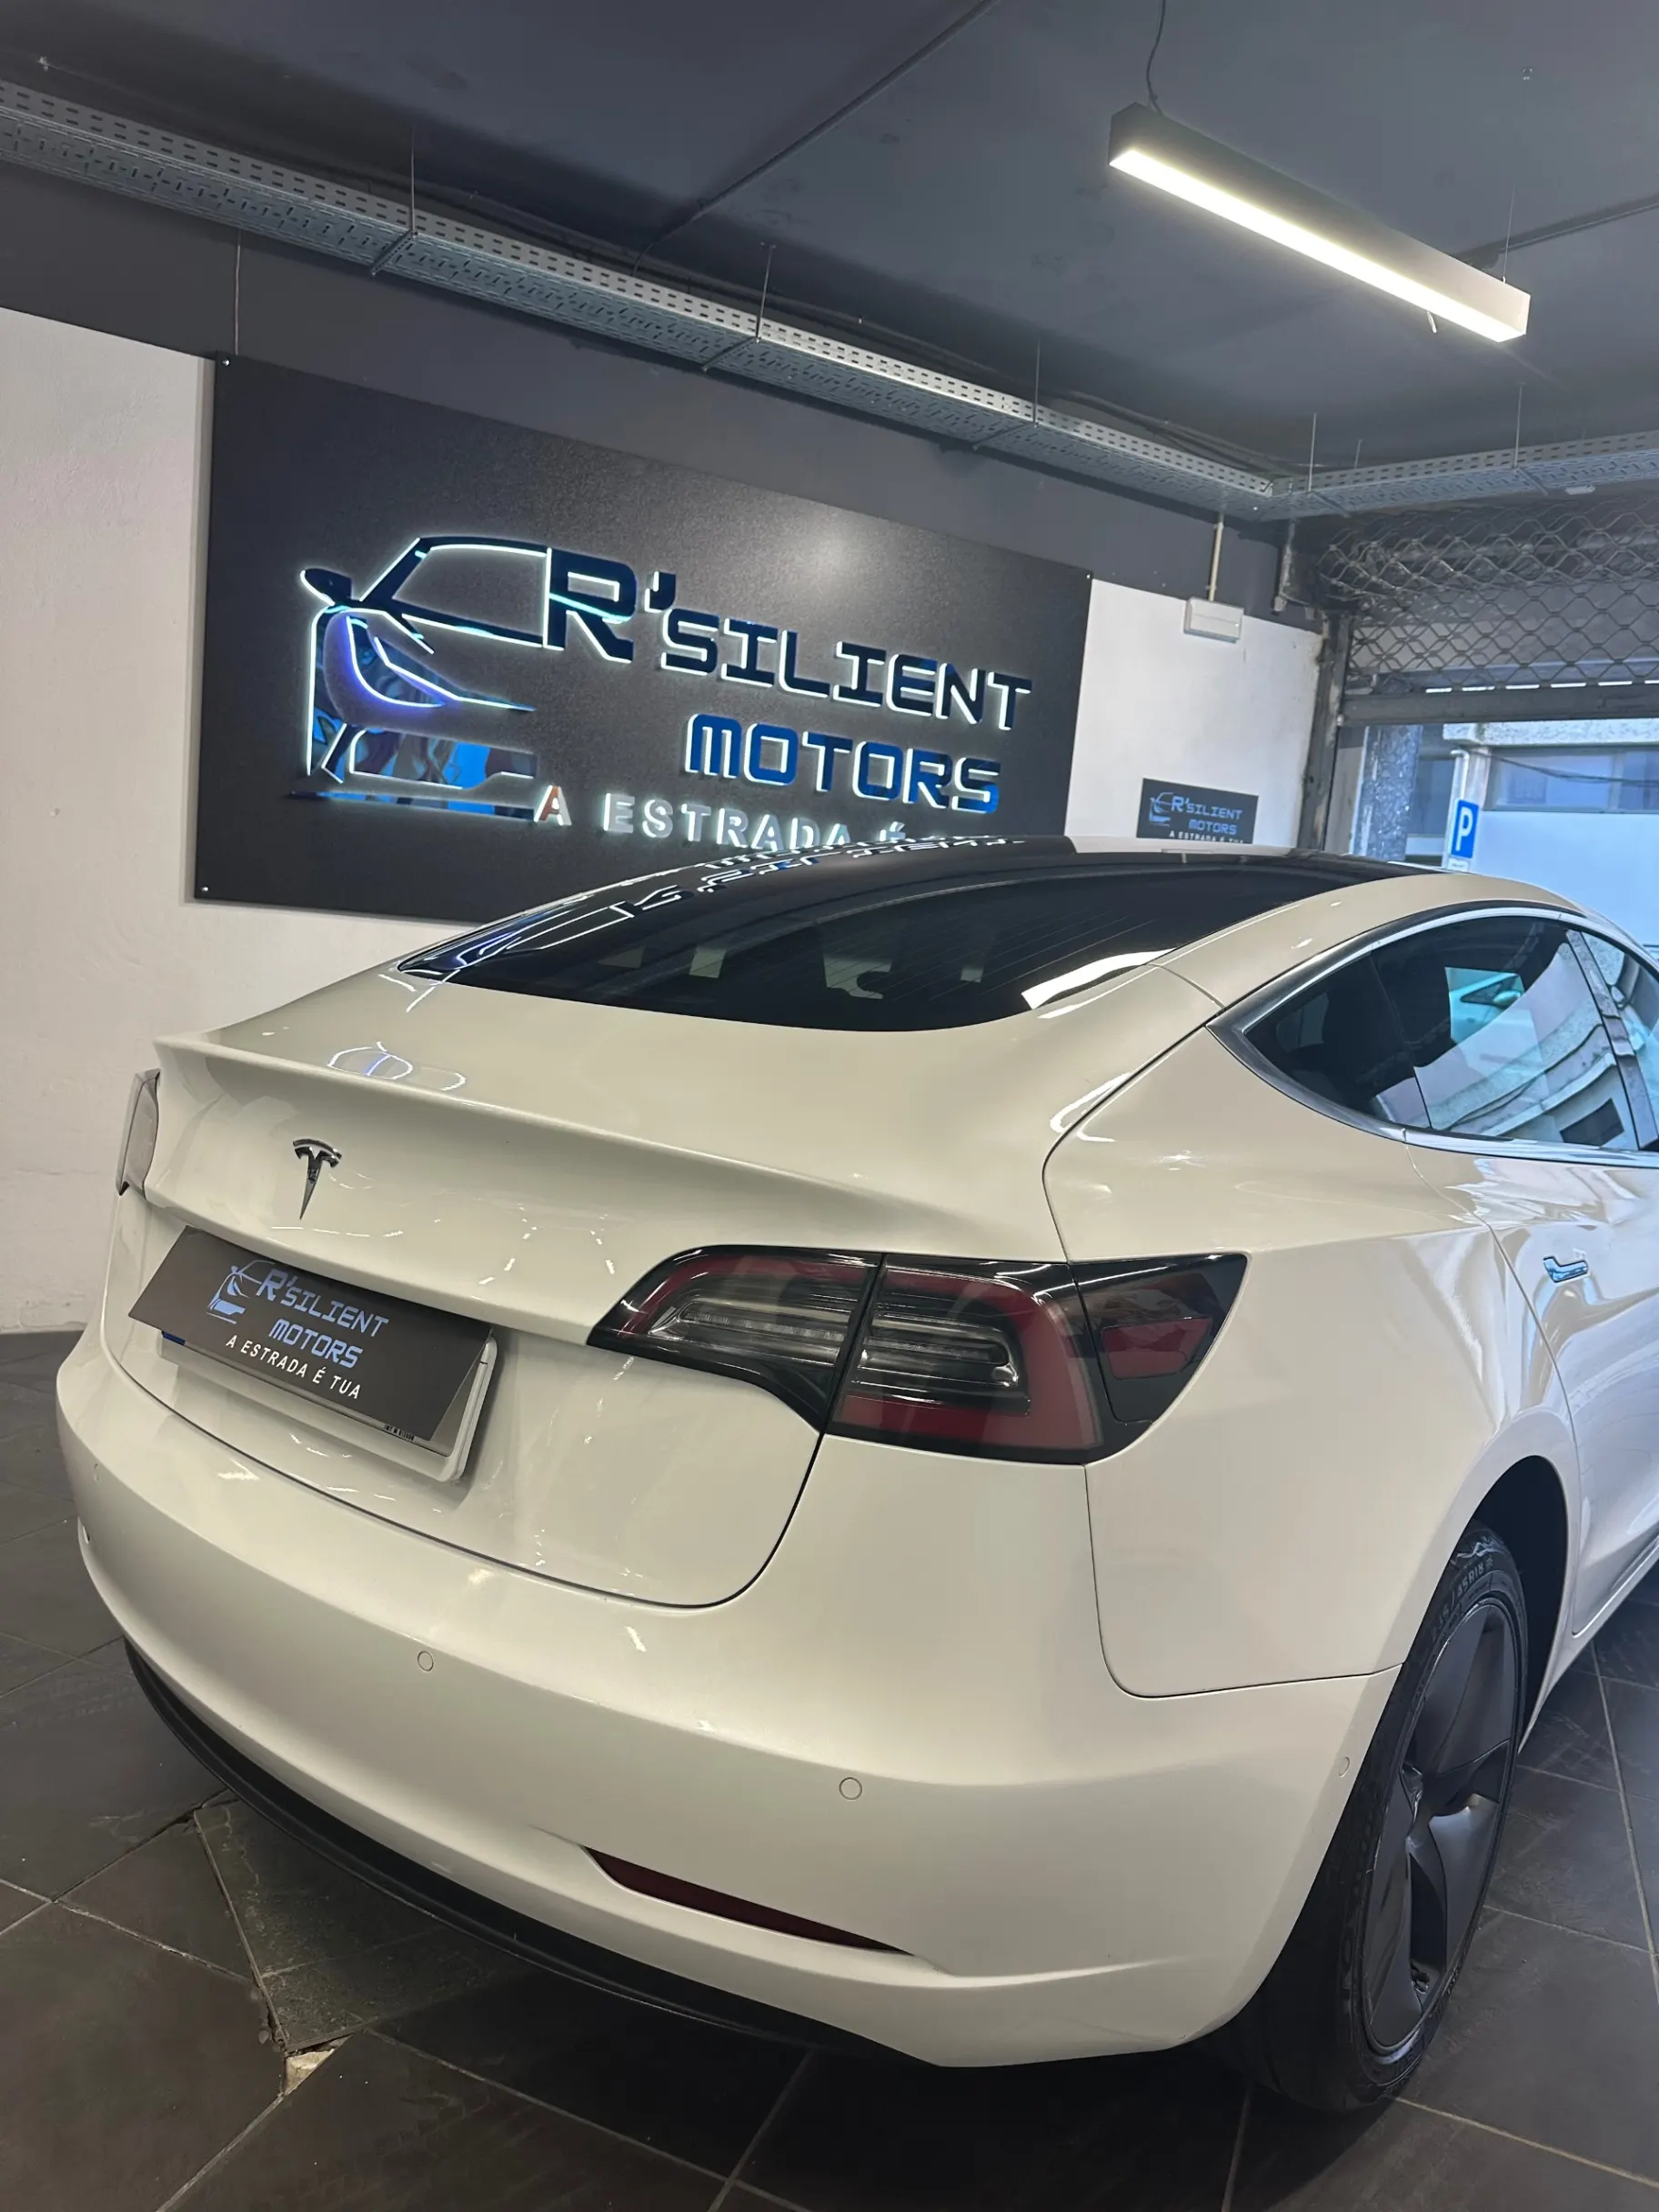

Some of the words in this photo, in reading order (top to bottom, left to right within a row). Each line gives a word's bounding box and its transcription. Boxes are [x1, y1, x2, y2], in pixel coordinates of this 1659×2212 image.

[543, 546, 1032, 730] R'SILIENT
[685, 713, 1000, 814] MOTORS
[534, 784, 572, 826] A
[603, 793, 850, 852] ESTRADA
[1171, 796, 1243, 820] R'SILIENT
[1189, 819, 1237, 835] MOTORS
[1456, 807, 1473, 851] P
[256, 1268, 389, 1337] R'SILIENT
[226, 1335, 237, 1349] A
[241, 1340, 308, 1378] ESTRADA
[313, 1367, 326, 1383] É
[330, 1375, 361, 1399] TUA
[268, 1319, 363, 1368] MOTORS
